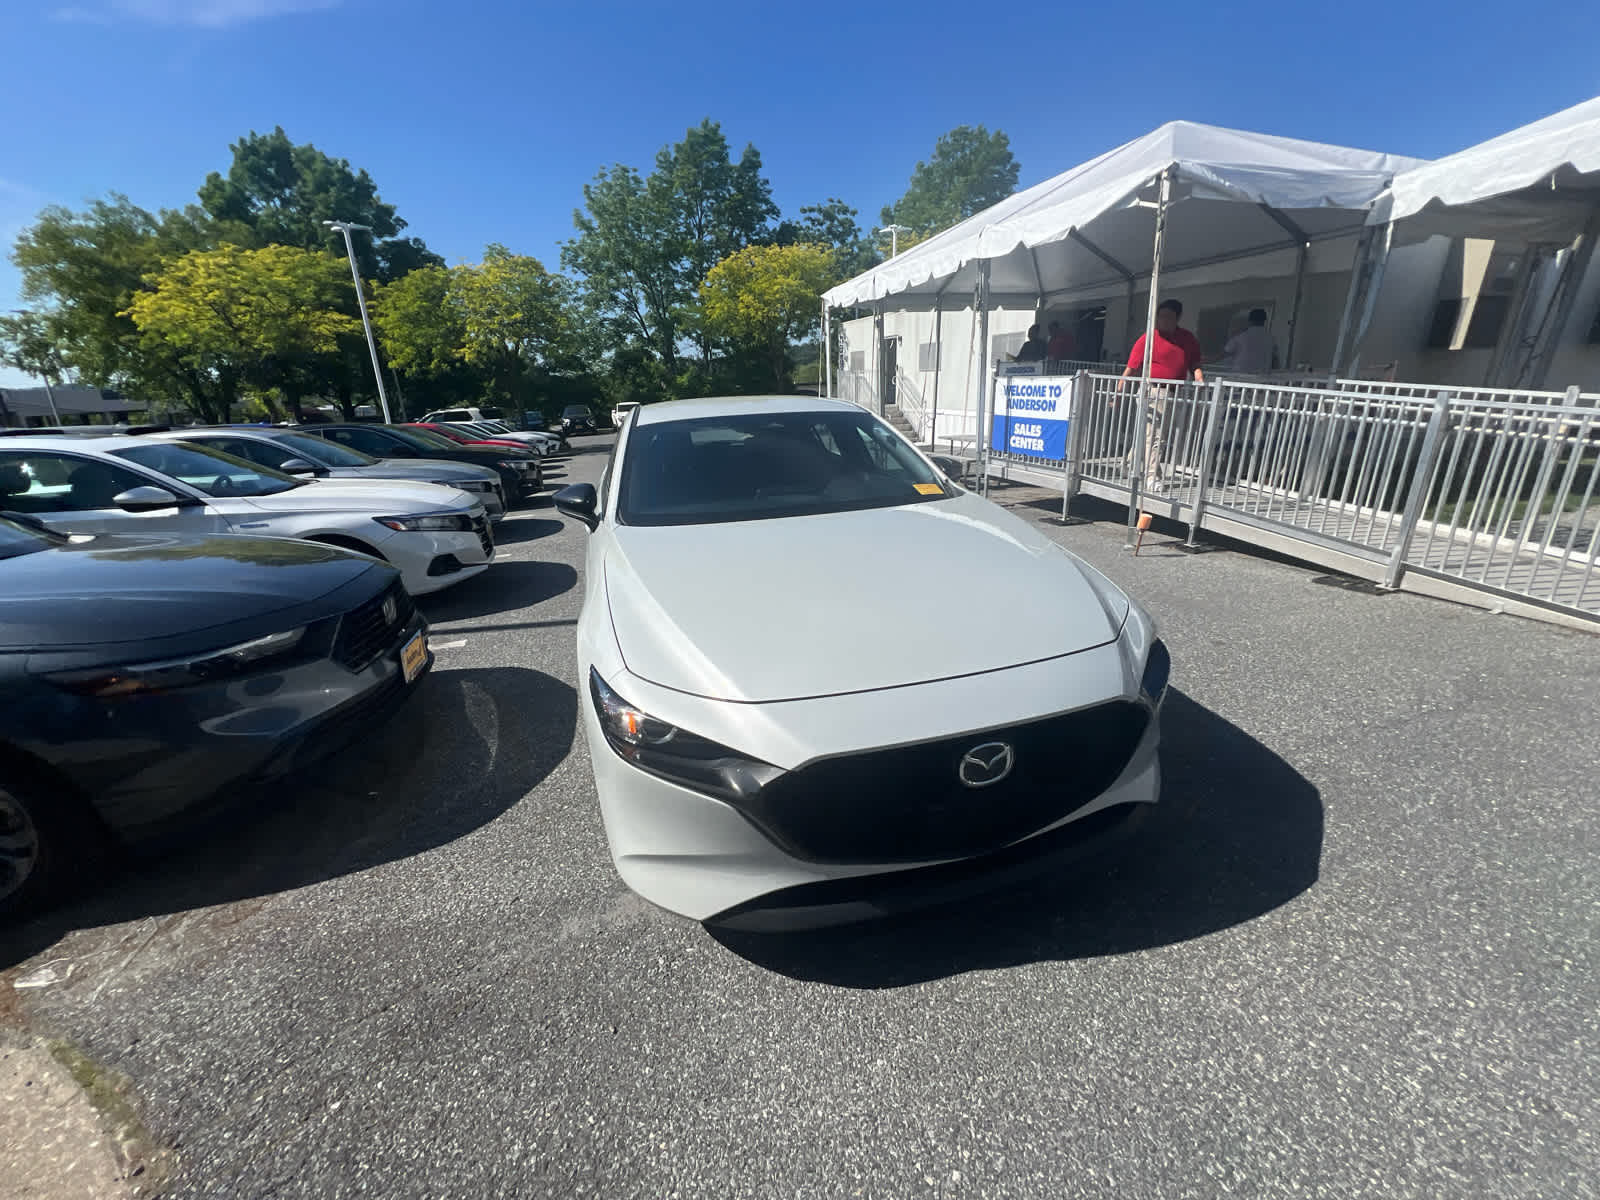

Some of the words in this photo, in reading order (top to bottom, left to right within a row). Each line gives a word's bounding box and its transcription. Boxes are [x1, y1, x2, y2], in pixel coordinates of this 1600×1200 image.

[1004, 385, 1047, 397] WELCOME
[1049, 385, 1062, 398] TO
[1007, 398, 1057, 412] ANDERSON
[1013, 423, 1042, 437] SALES
[1009, 435, 1044, 451] CENTER
